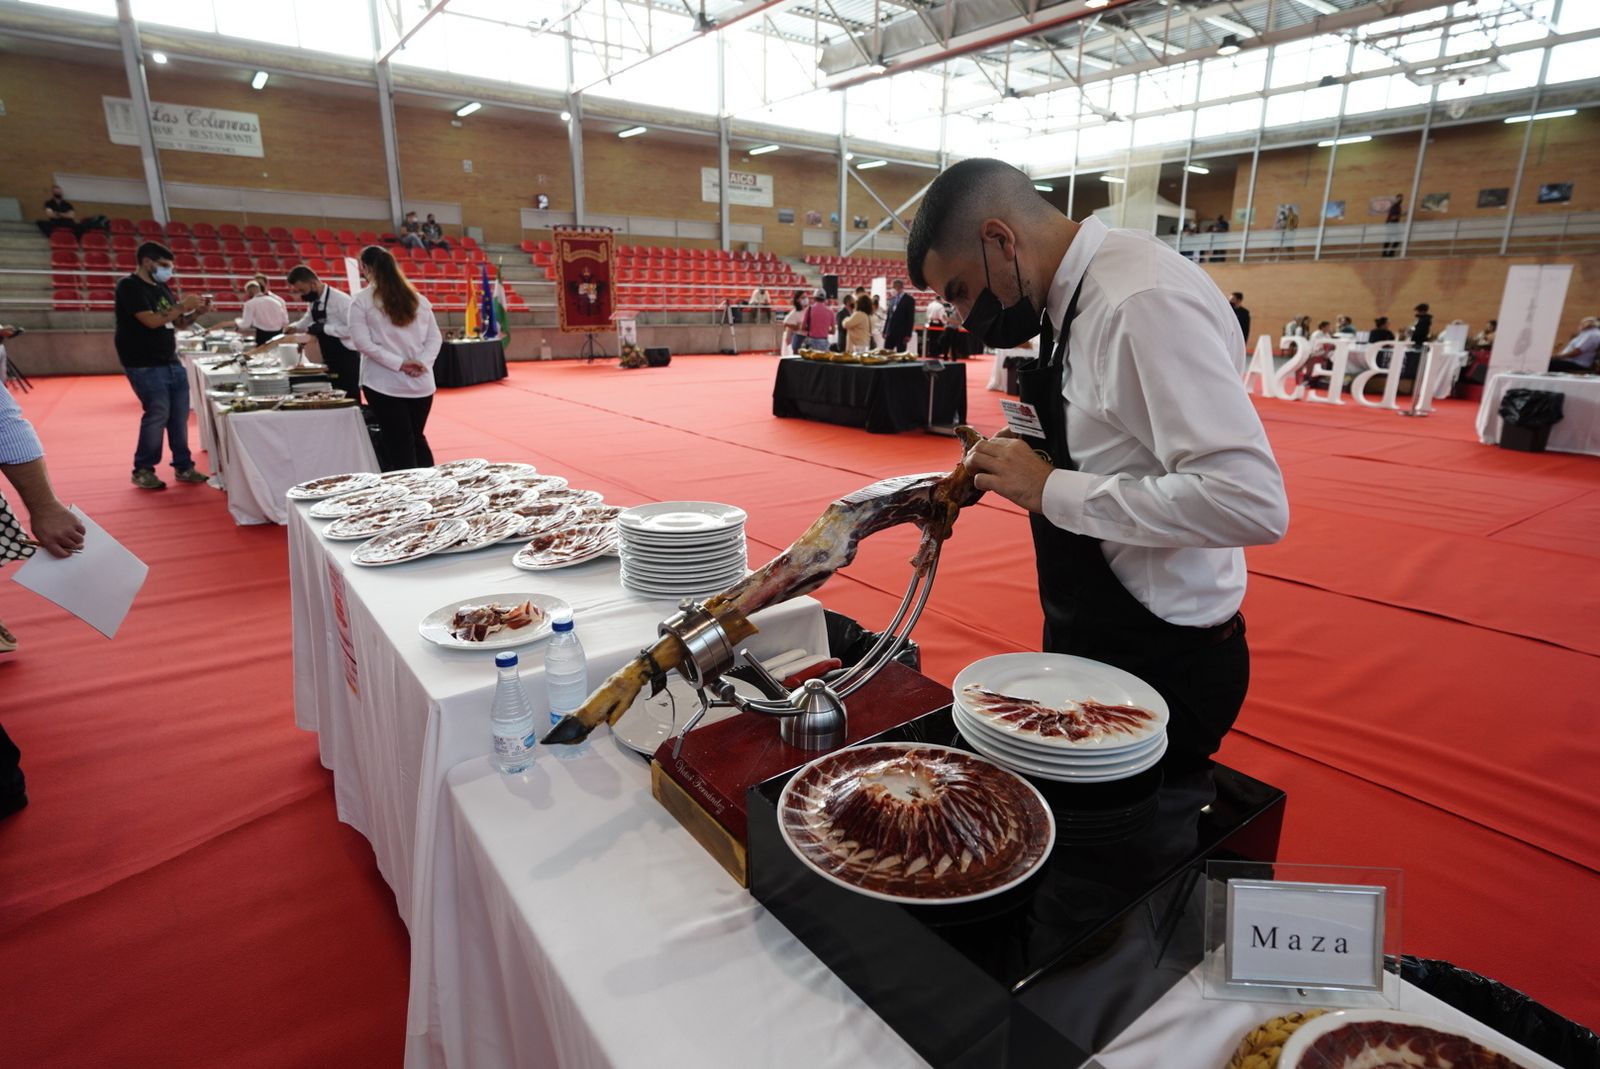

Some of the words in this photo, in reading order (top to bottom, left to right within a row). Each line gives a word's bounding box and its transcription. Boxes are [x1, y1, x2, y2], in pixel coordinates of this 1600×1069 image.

[152, 106, 179, 123] Las
[186, 109, 258, 133] Columnas
[1251, 925, 1349, 954] Maza
